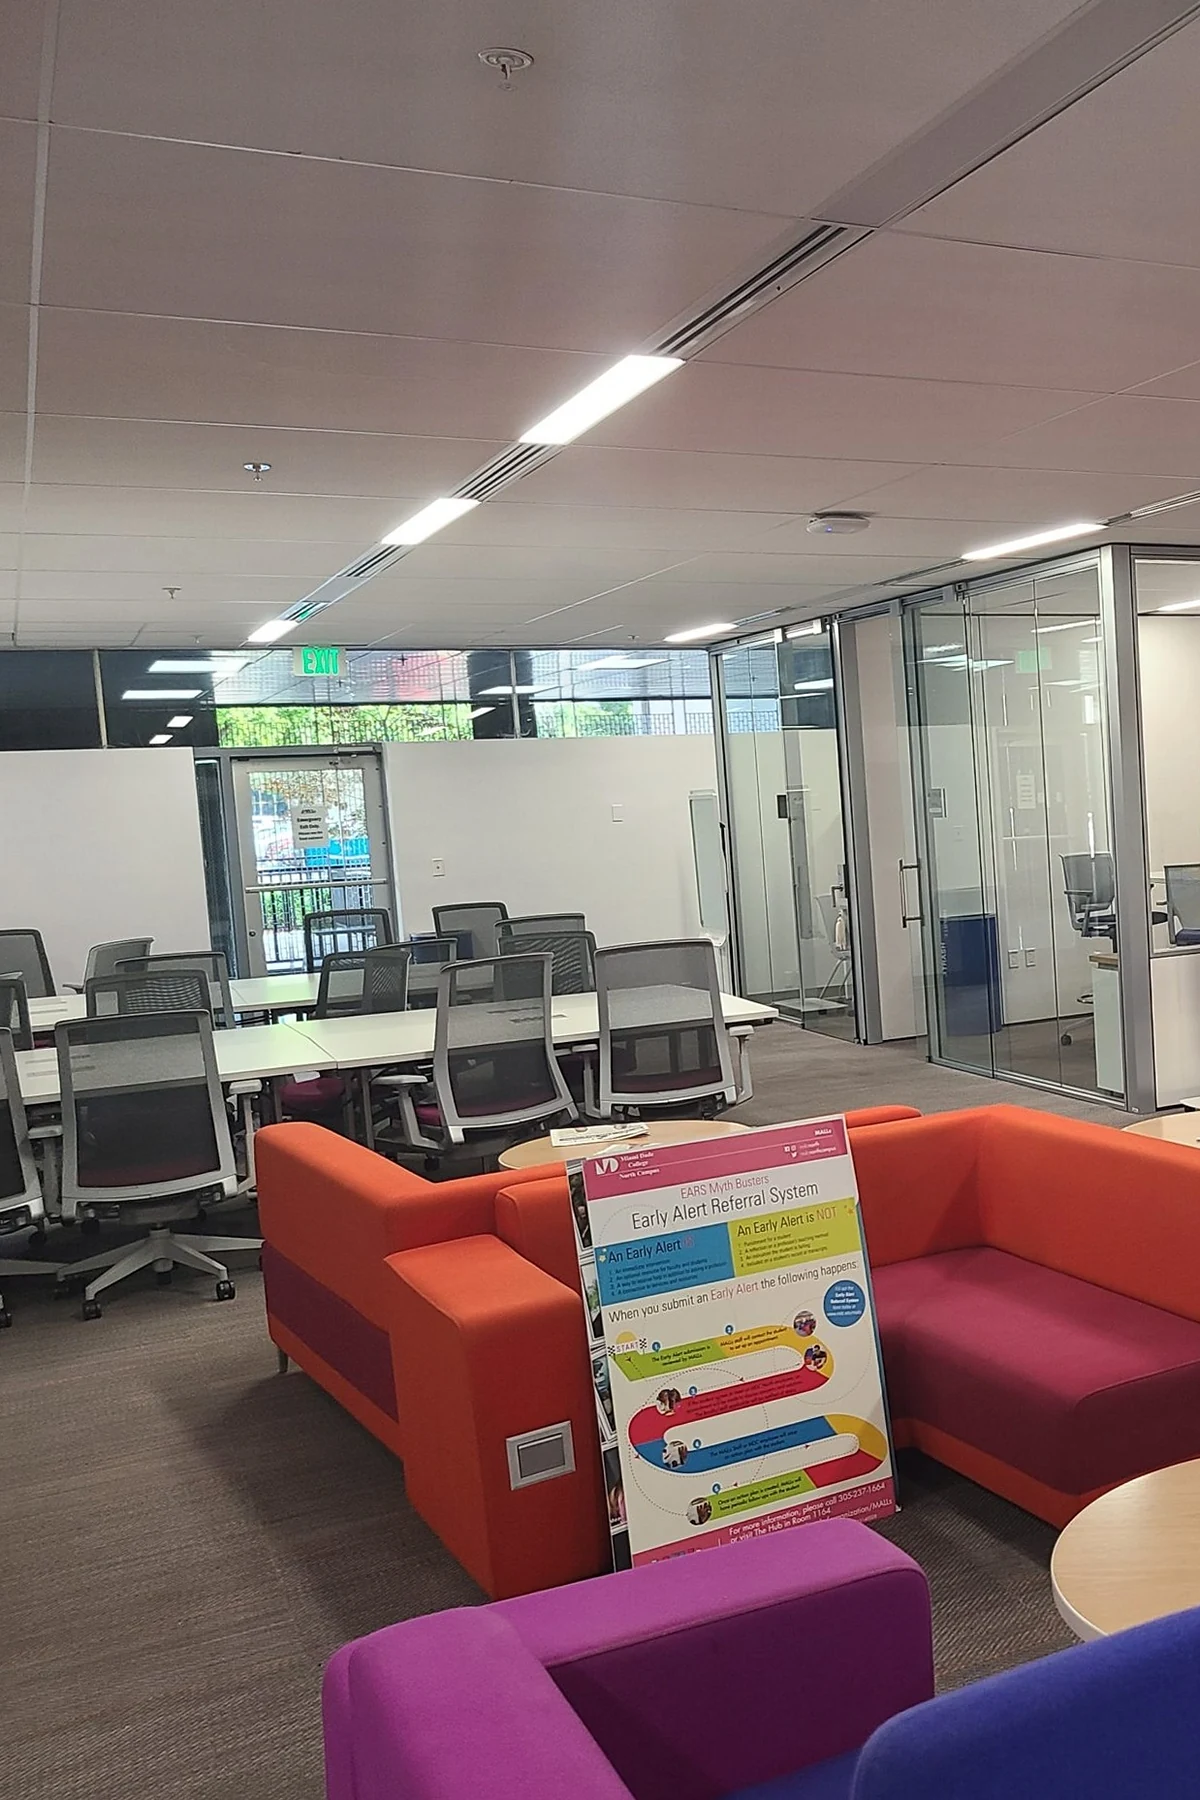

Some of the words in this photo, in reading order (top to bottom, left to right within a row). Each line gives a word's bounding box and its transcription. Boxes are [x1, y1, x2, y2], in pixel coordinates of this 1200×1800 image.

[302, 647, 339, 675] EXIT
[620, 1153, 639, 1162] Miami
[639, 1151, 654, 1159] Dade
[627, 1160, 649, 1168] College
[619, 1171, 637, 1179] North
[636, 1168, 660, 1177] Campus
[680, 1184, 707, 1199] EARS
[708, 1179, 734, 1195] Myth
[735, 1175, 770, 1190] Busters
[631, 1208, 668, 1230] Early
[672, 1200, 708, 1222] Alert
[711, 1190, 766, 1214] Referral
[770, 1182, 819, 1205] System
[736, 1224, 752, 1237] An
[753, 1218, 778, 1234] Early
[780, 1213, 804, 1229] Alert
[806, 1212, 815, 1223] is
[816, 1206, 837, 1221] NOT
[607, 1250, 624, 1264] An
[626, 1244, 653, 1260] Early
[655, 1239, 682, 1254] Alert
[608, 1306, 640, 1323] When
[641, 1302, 660, 1318] you
[661, 1295, 695, 1311] submit
[696, 1292, 709, 1304] an
[710, 1286, 735, 1302] Early
[736, 1281, 759, 1295] Alert
[760, 1277, 776, 1290] the
[777, 1268, 819, 1283] following
[616, 1341, 639, 1353] START
[729, 1526, 741, 1536] For
[742, 1521, 760, 1532] more
[802, 1502, 824, 1515] please
[825, 1497, 837, 1507] call
[838, 1482, 886, 1503] 305-237-1664
[753, 1527, 767, 1538] The
[768, 1521, 783, 1532] Hub
[784, 1518, 791, 1528] in
[792, 1513, 812, 1525] Room
[813, 1507, 832, 1520] 1164
